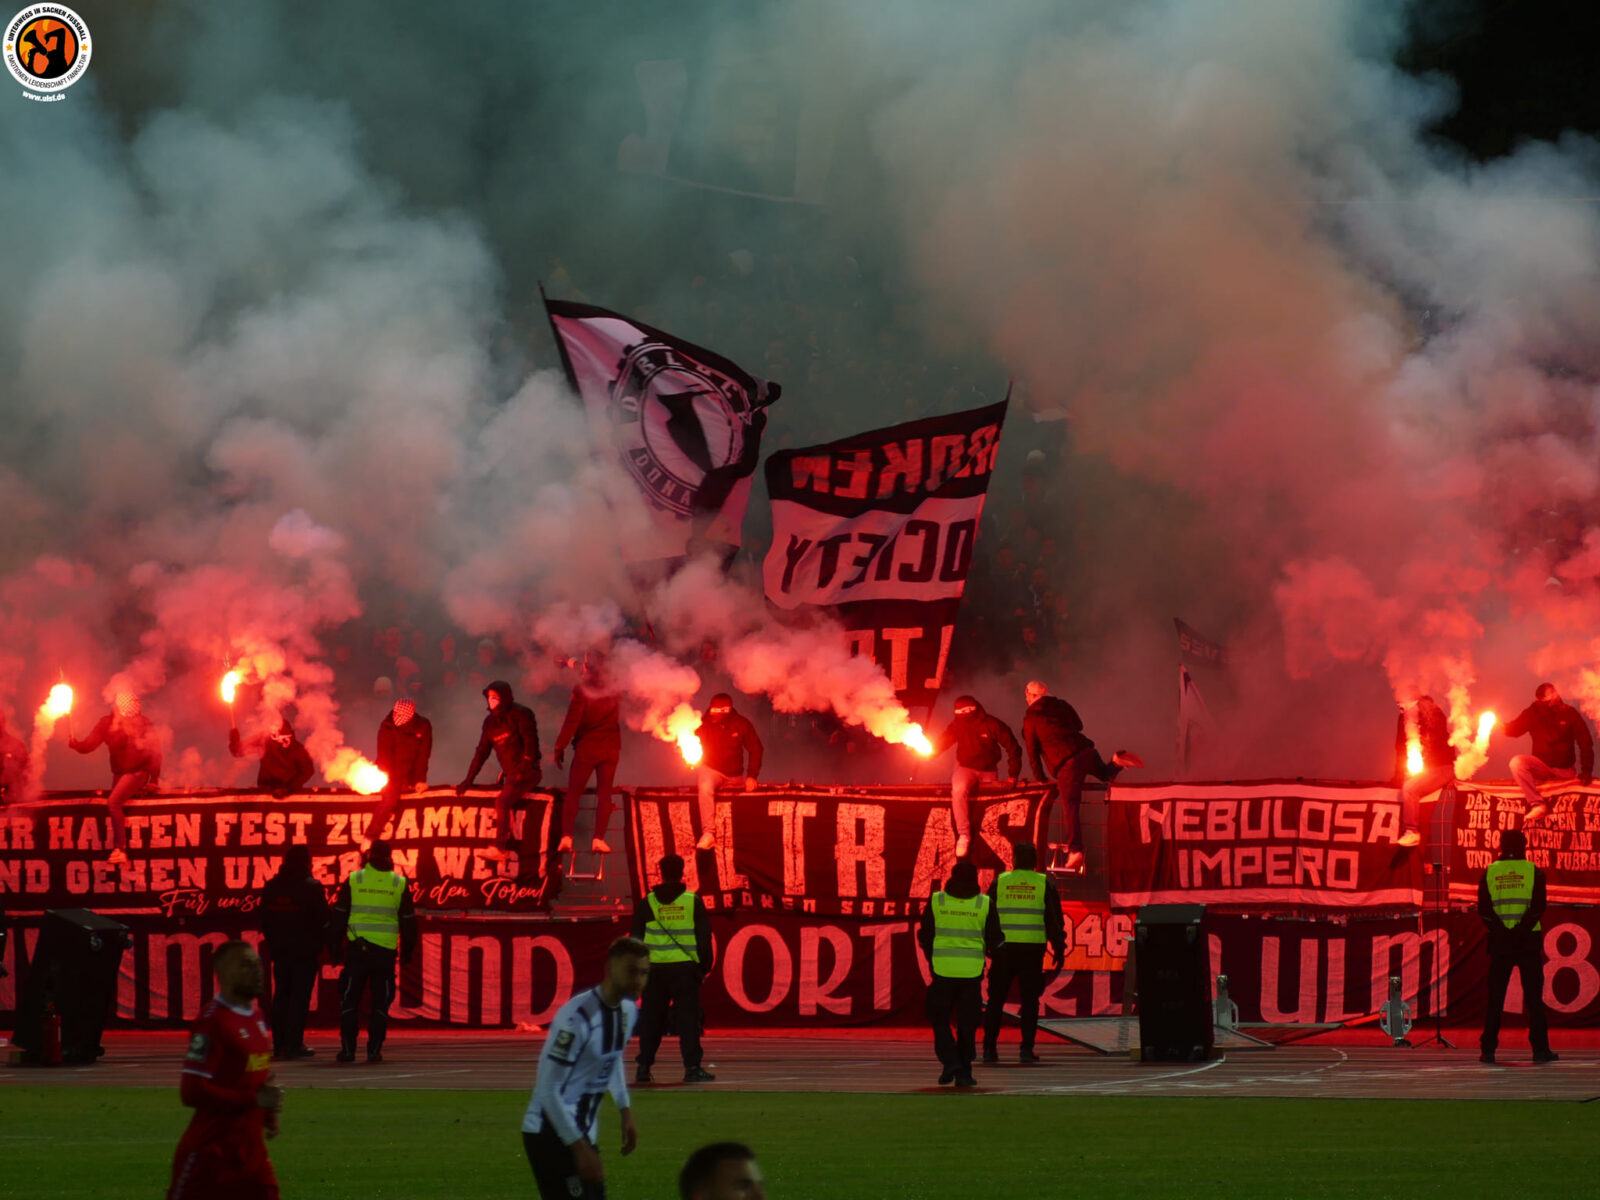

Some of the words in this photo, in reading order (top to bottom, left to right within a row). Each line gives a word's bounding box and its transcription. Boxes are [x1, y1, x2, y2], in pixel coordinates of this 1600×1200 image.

[1465, 793, 1491, 811] DAS
[215, 812, 313, 847] FEST
[1140, 800, 1400, 844] NEBULOSA
[1468, 810, 1491, 829] DIE
[1499, 812, 1515, 830] 90
[1485, 829, 1501, 849] 90
[1570, 832, 1593, 850] AM
[66, 857, 208, 894] GEHEN
[1178, 845, 1359, 891] IMPERO
